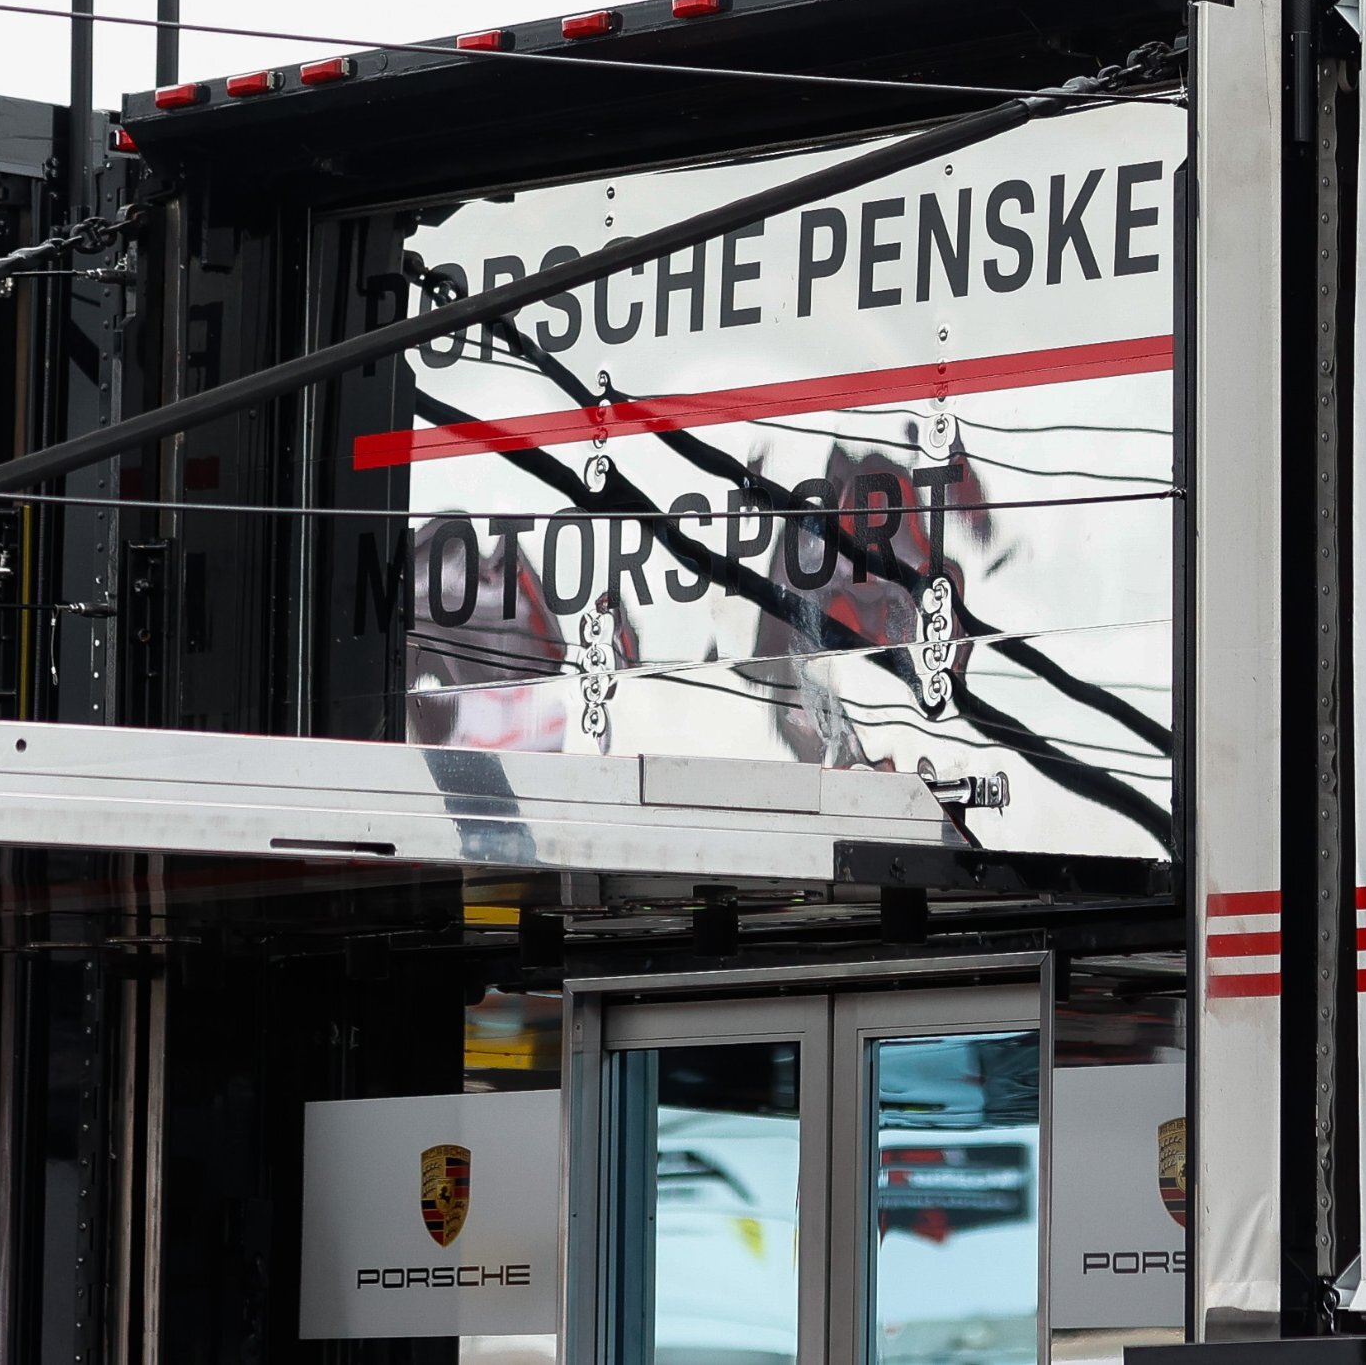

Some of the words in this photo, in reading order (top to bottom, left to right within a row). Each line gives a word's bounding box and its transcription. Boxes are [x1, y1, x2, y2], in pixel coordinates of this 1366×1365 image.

[796, 160, 1165, 319] PENSKE
[352, 464, 965, 635] MOTORSPORT
[357, 1264, 532, 1290] PORSCHE
